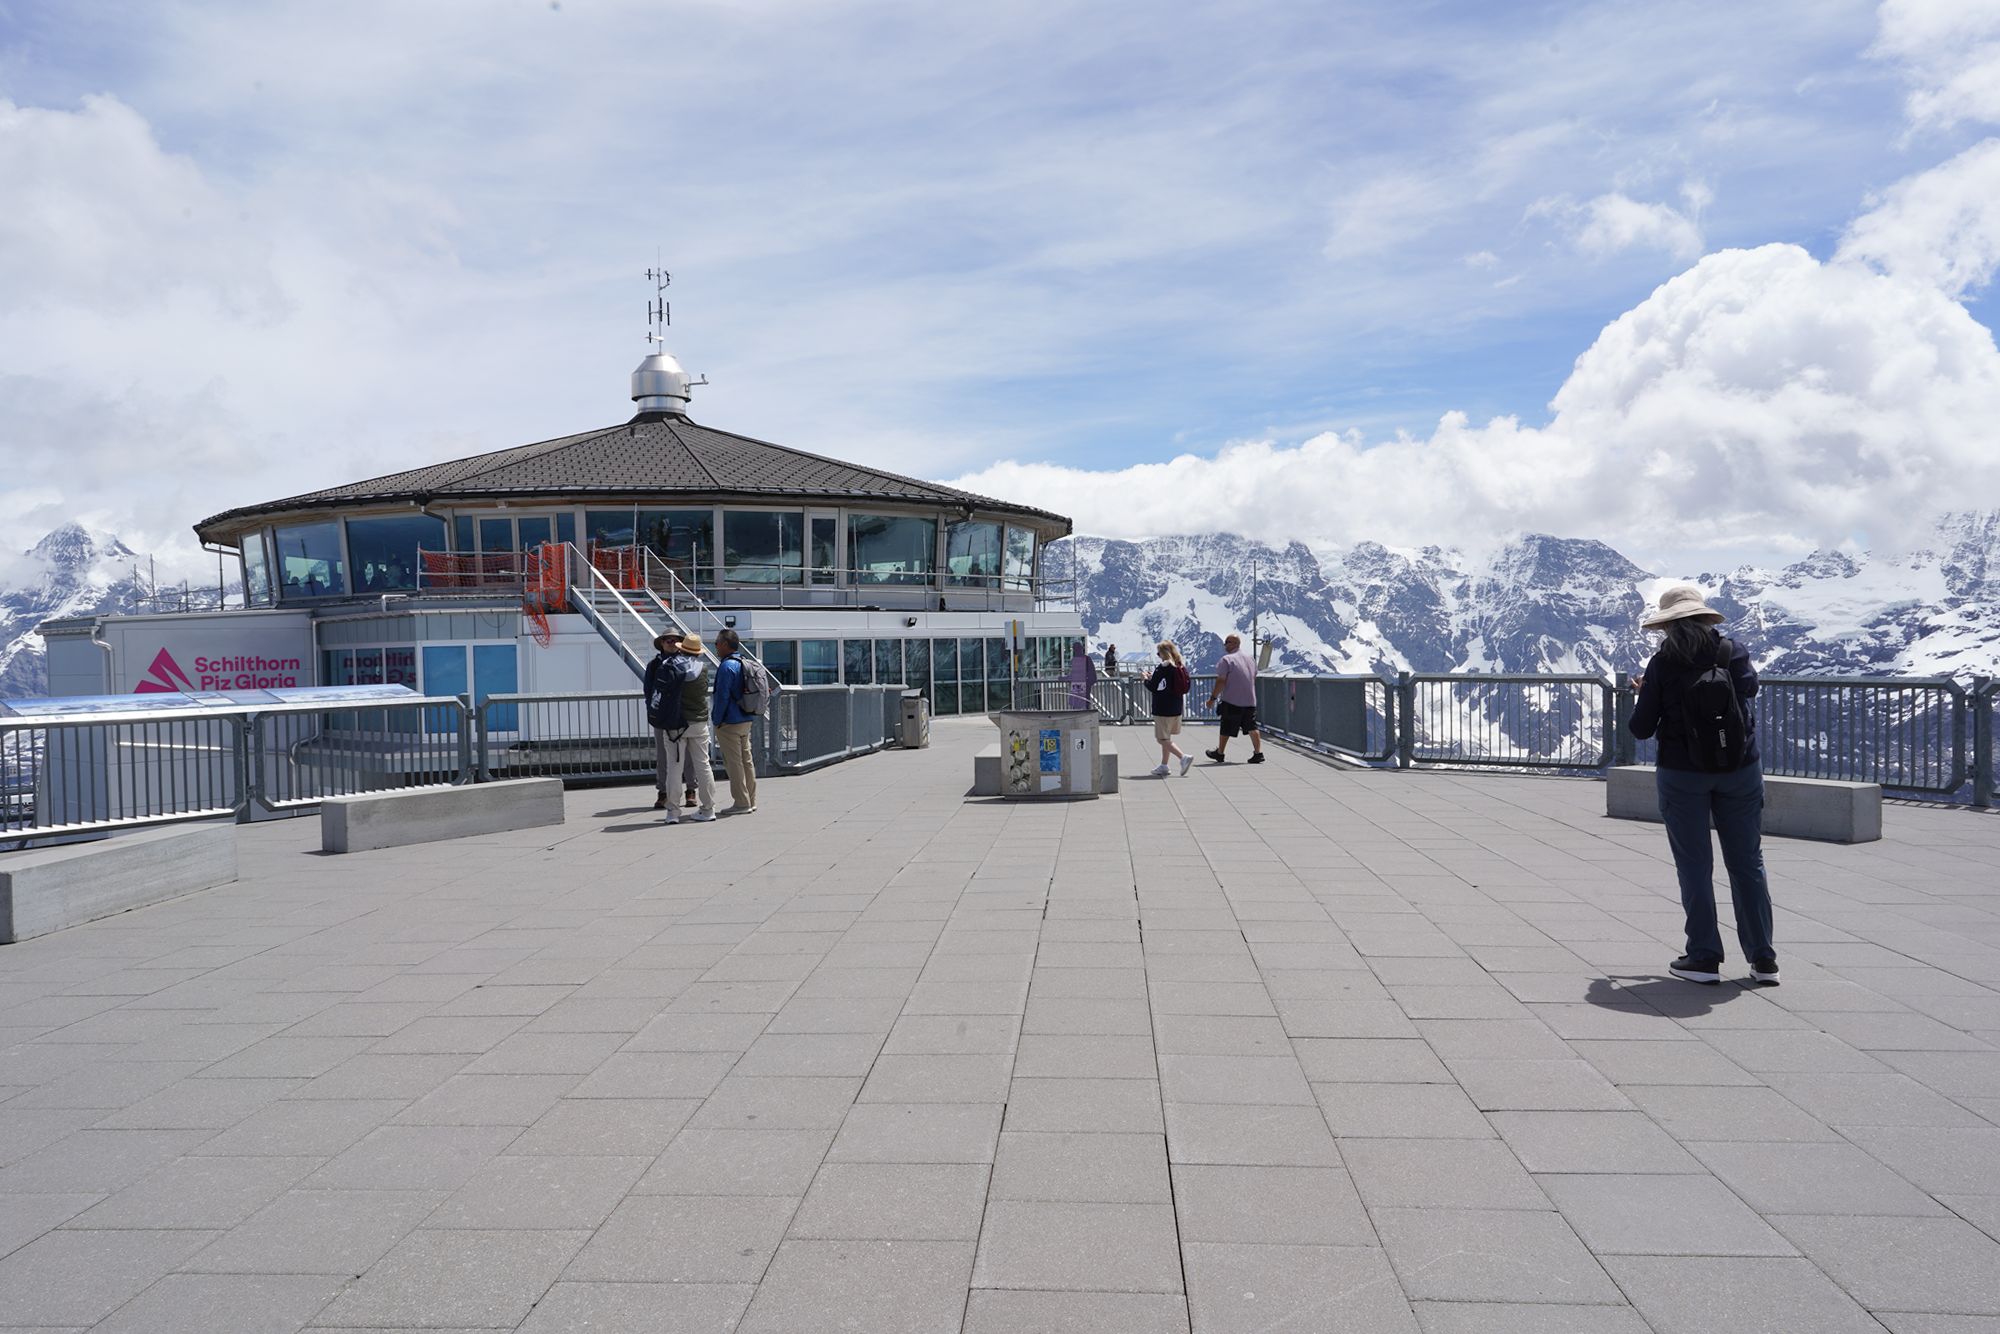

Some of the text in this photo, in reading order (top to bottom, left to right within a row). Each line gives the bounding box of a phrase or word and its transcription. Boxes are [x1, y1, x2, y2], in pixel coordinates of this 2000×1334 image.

[195, 655, 300, 672] Schilthorn
[201, 673, 297, 691] Piz Gloria
